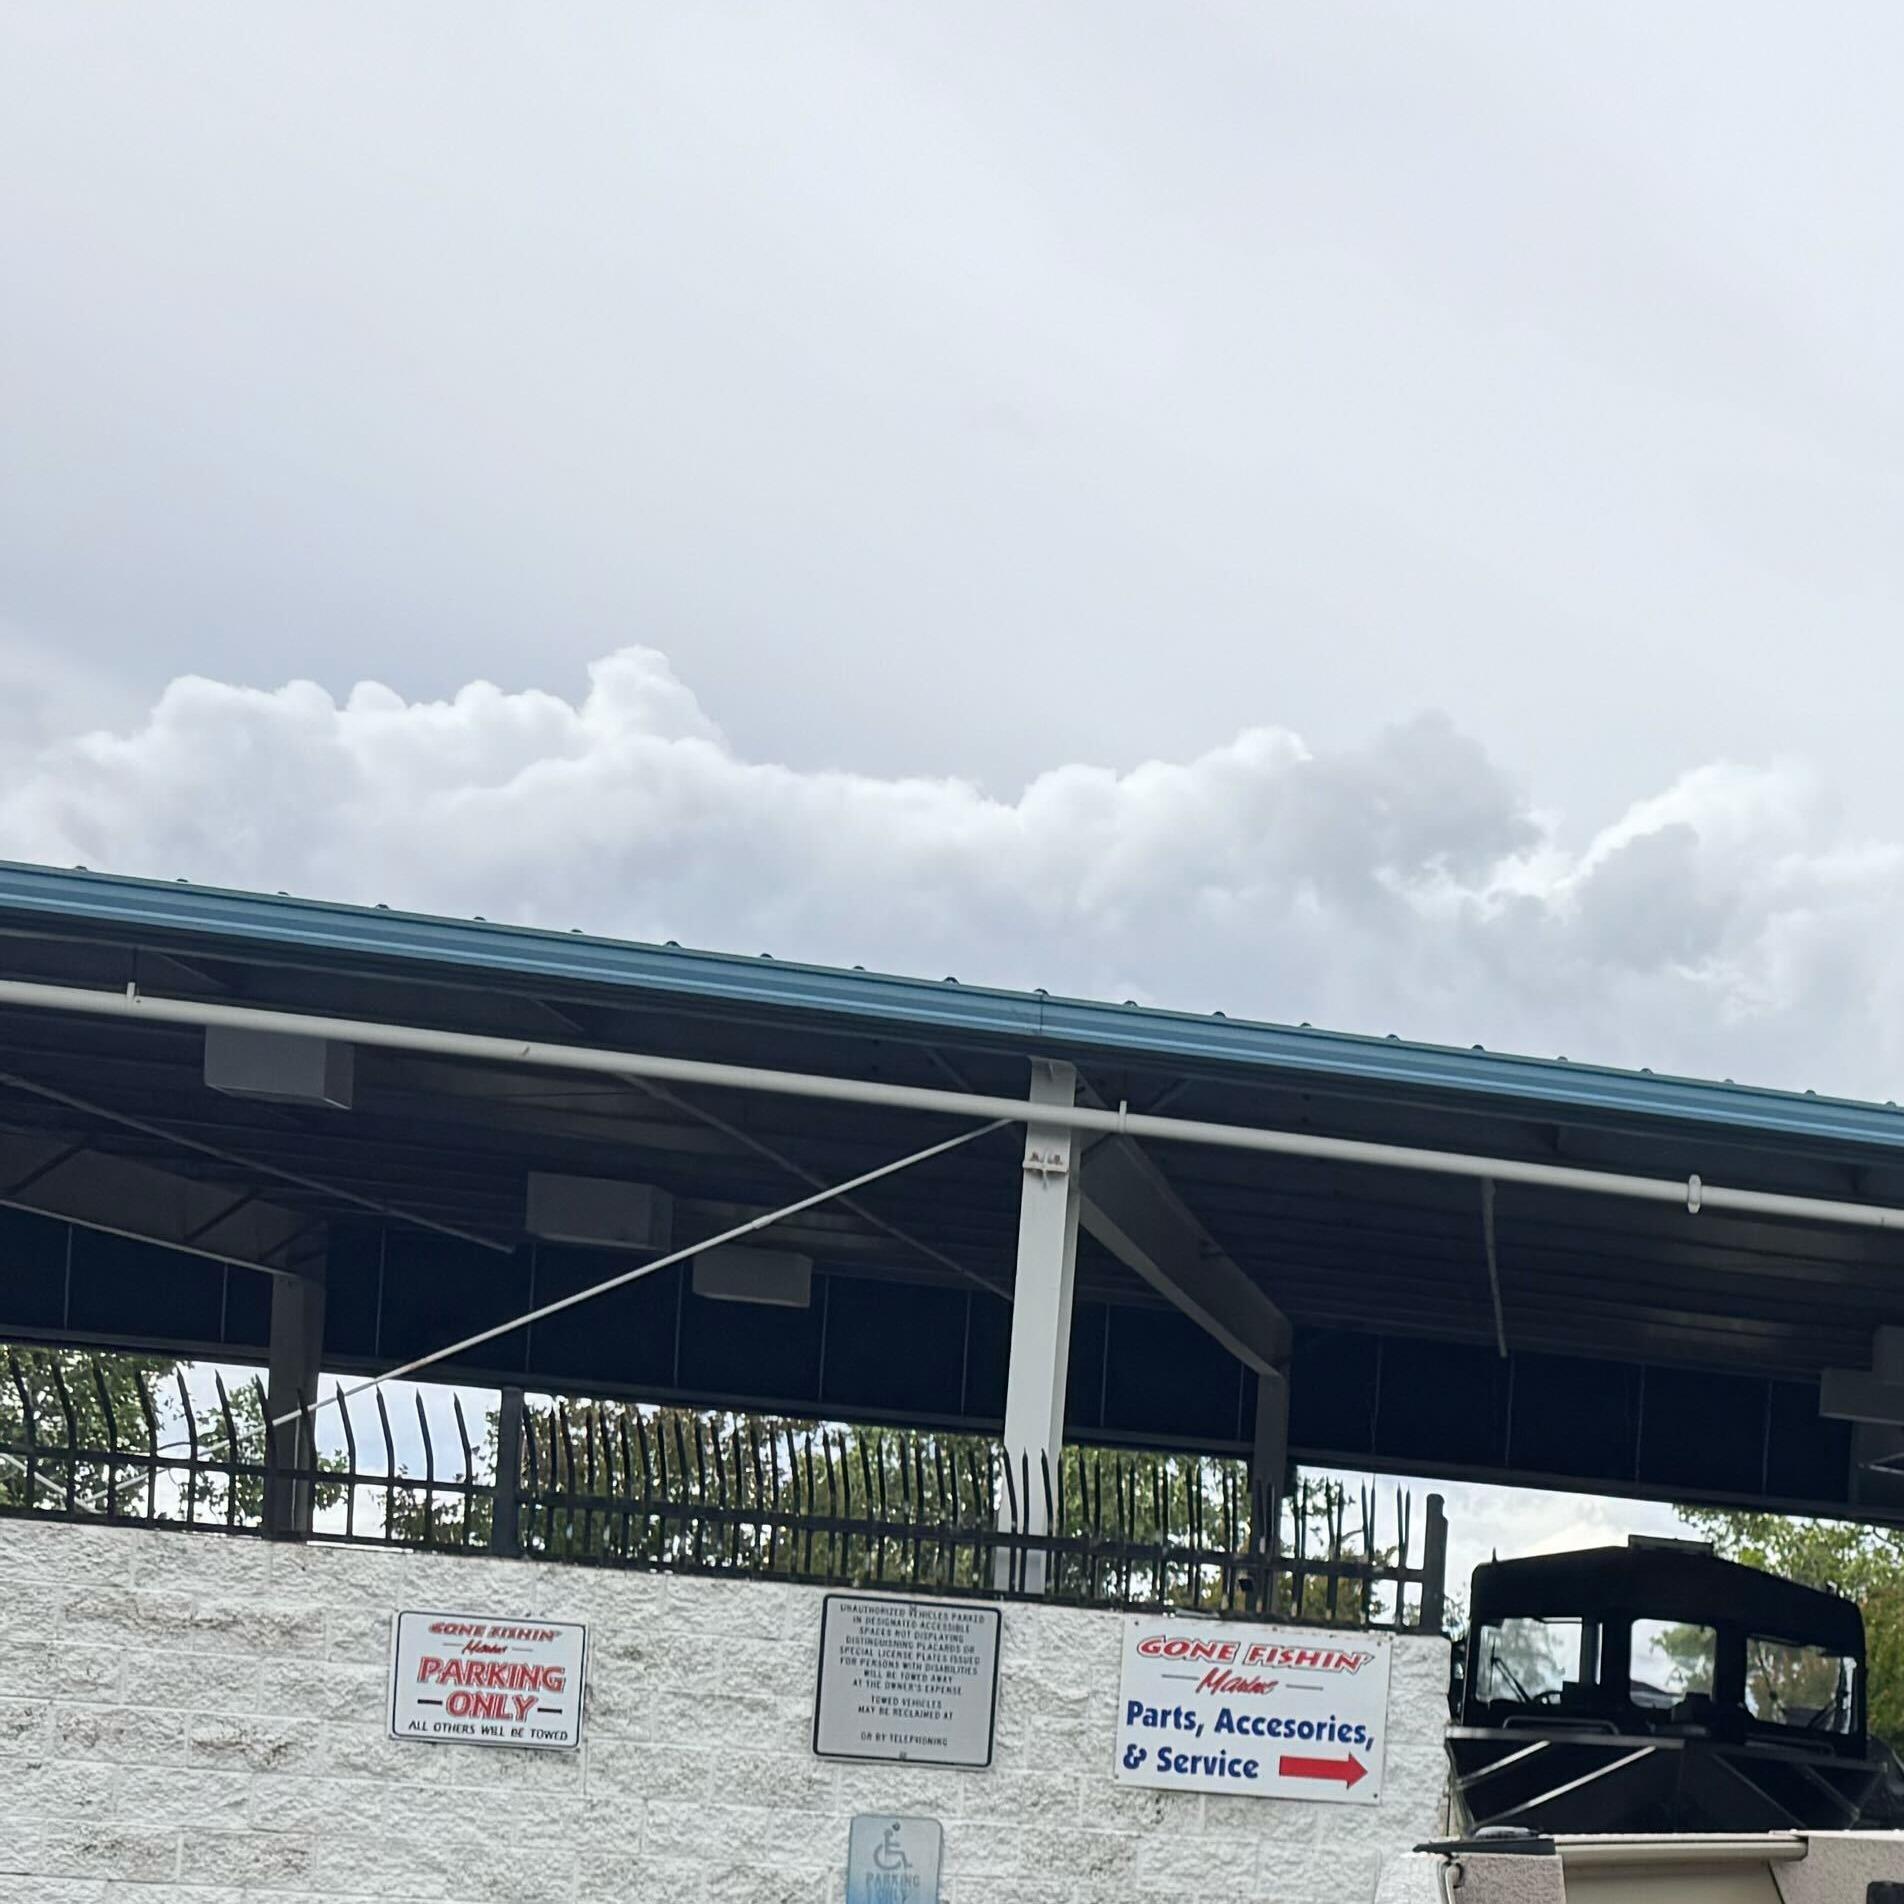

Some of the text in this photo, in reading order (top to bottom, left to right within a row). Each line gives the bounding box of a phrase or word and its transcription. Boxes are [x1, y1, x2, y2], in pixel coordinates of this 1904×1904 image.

[840, 1604, 905, 1616] UNAUTHORIZED
[951, 1613, 985, 1624] PARKED
[428, 1621, 486, 1638] GONE
[853, 1616, 970, 1634] IN DESIGNATED ACCESSIBLE
[859, 1627, 964, 1643] SPACES NOT DISPLAYING
[840, 1646, 981, 1665] SPECIAL LICENSE PLATES ISSUED
[916, 1642, 961, 1653] PLACARDS
[963, 1645, 975, 1654] OR
[1137, 1635, 1241, 1665] GONE
[417, 1655, 567, 1694] PARKING
[840, 1657, 978, 1676] FOR PERSONS WITH DISABILITIES
[863, 1669, 953, 1683] WILL BE TOWED AWAY
[853, 1679, 963, 1696] AT THE OWNER'S EXPENSE
[445, 1689, 539, 1723] ONLY
[871, 1695, 943, 1710] TOWED VEHICLES
[858, 1706, 953, 1721] MAY BE RECLAIMED AT
[408, 1720, 568, 1741] ALL OTHERS WILL BE TOWED
[1126, 1700, 1375, 1752] Parts, Accesories,
[861, 1731, 948, 1747] OR BY TELEPHONING
[1122, 1743, 1260, 1779] & Service
[866, 1871, 921, 1888] PARKING
